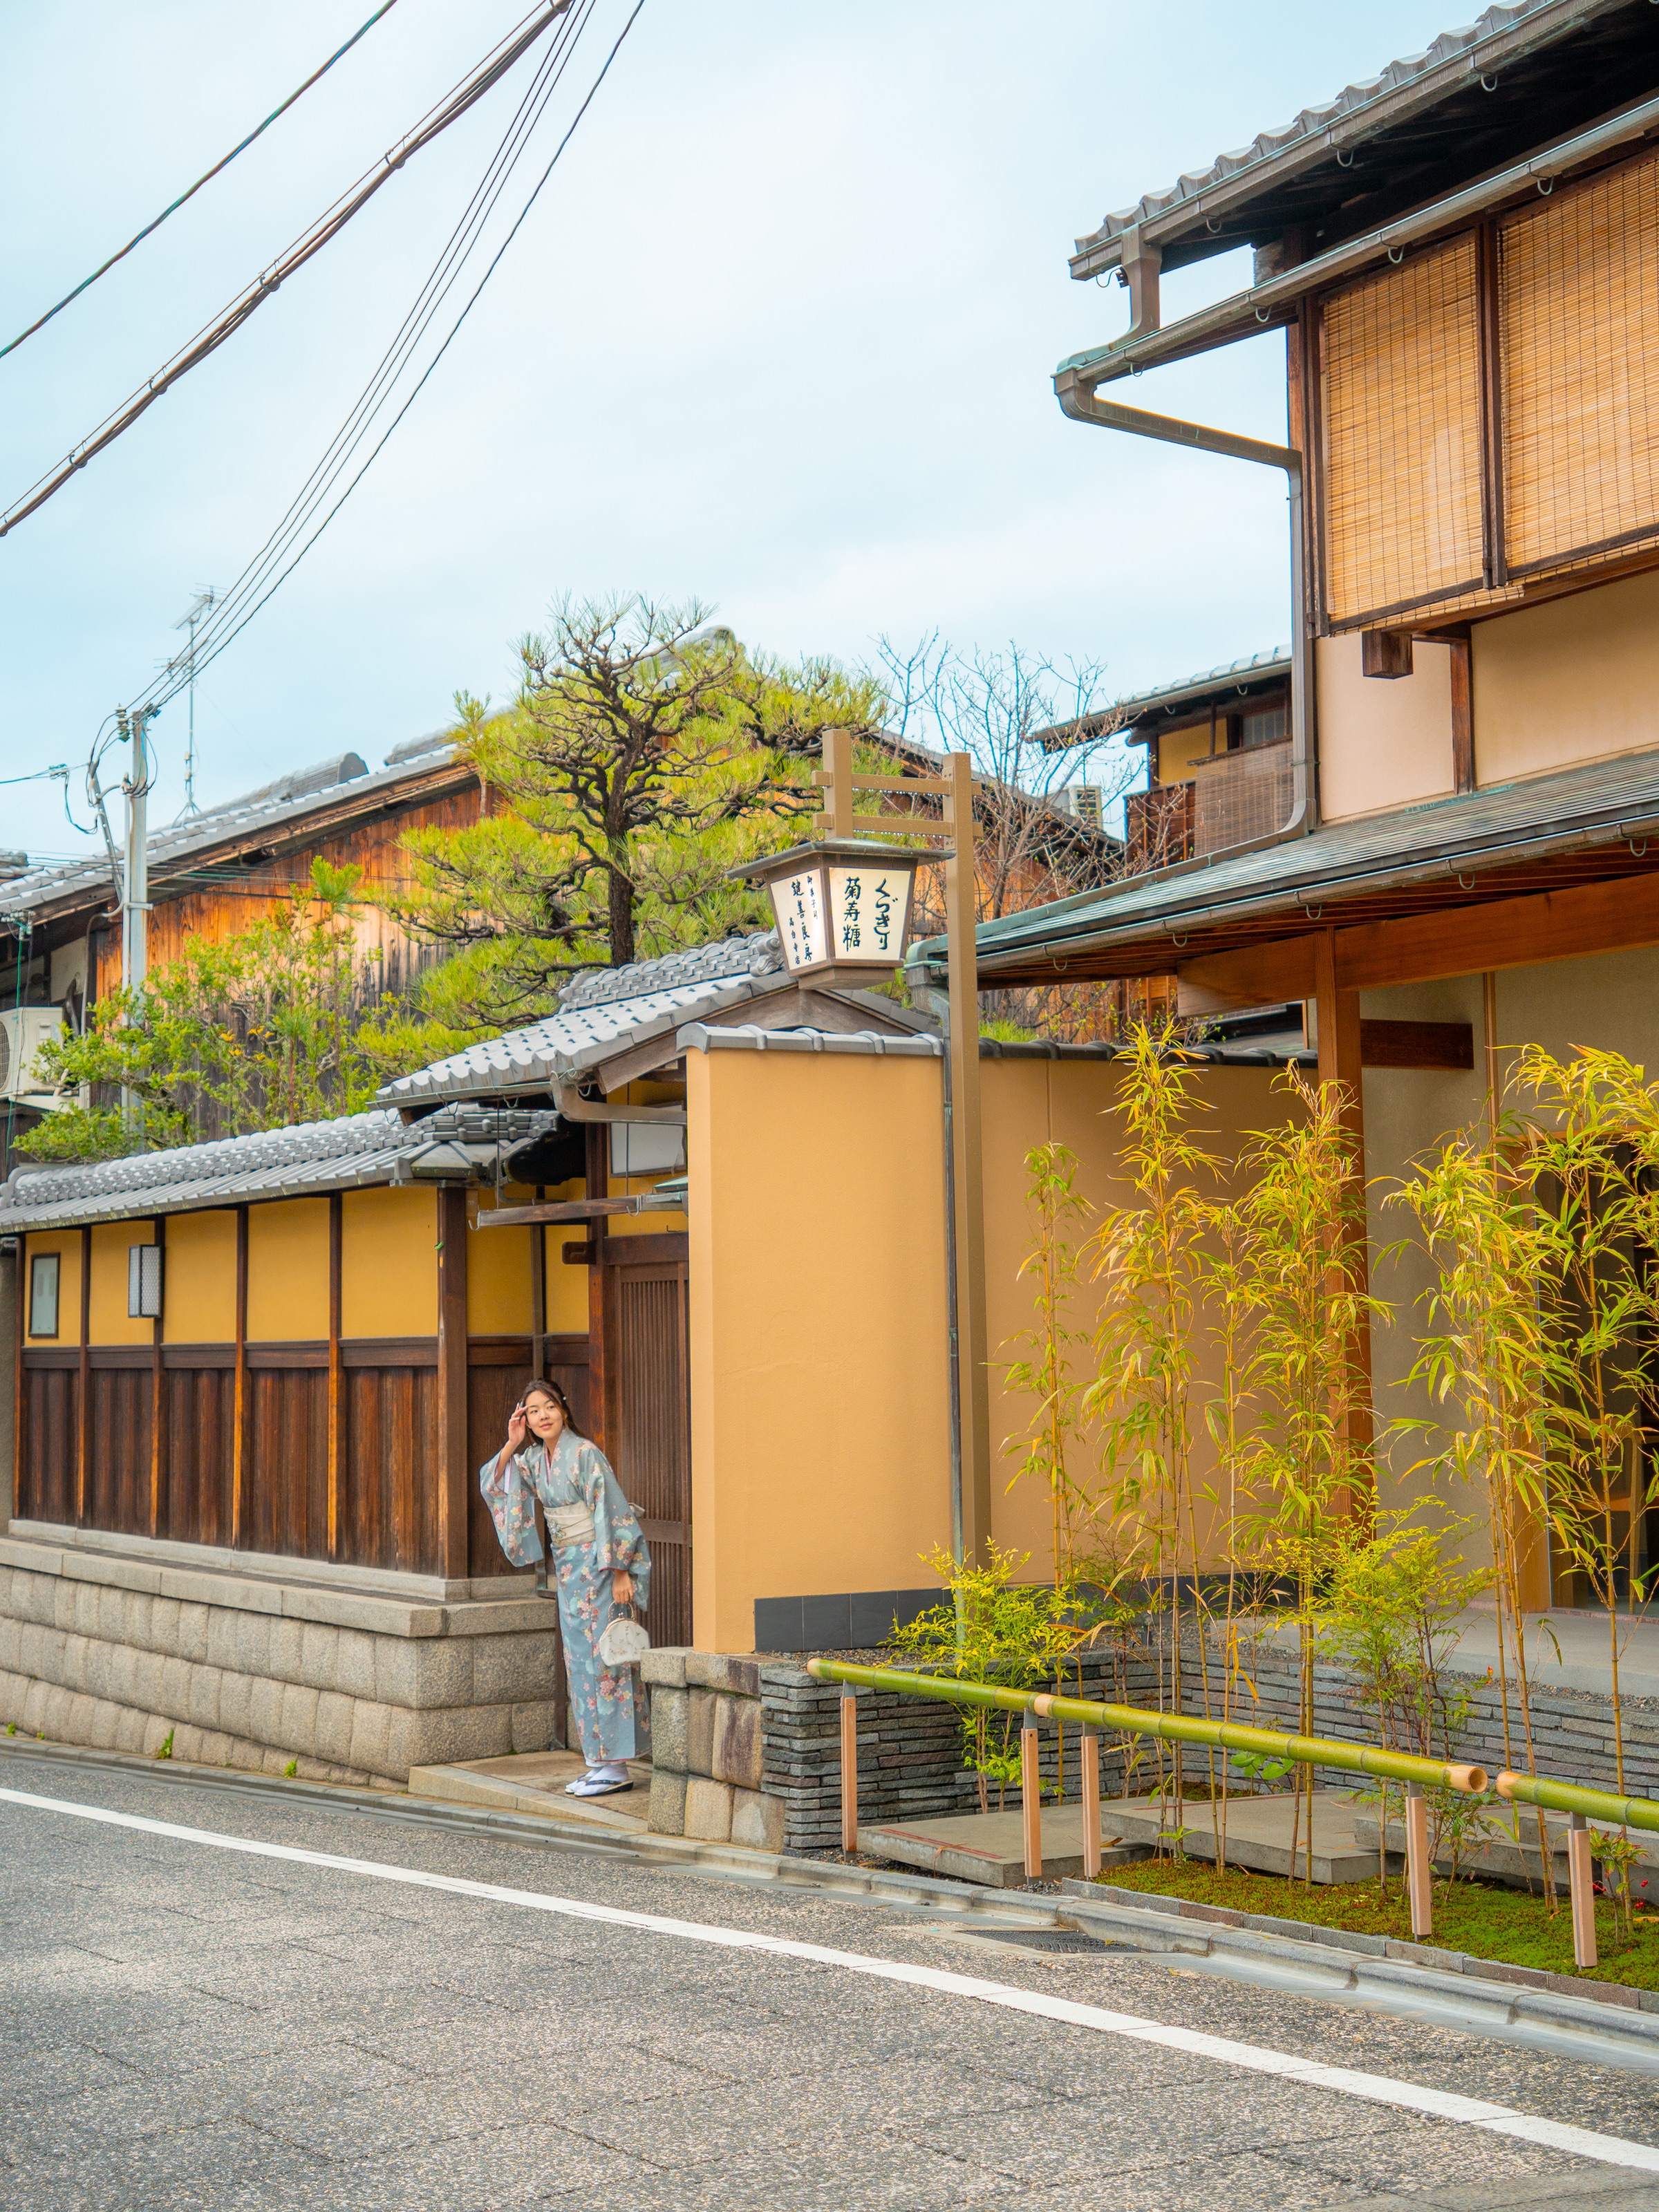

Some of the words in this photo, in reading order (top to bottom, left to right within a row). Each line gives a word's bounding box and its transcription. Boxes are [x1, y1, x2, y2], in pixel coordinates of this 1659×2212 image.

[789, 917, 800, 965] 高台寺店
[791, 879, 812, 962] 鍵善良房
[843, 877, 861, 952] 菊寿糖
